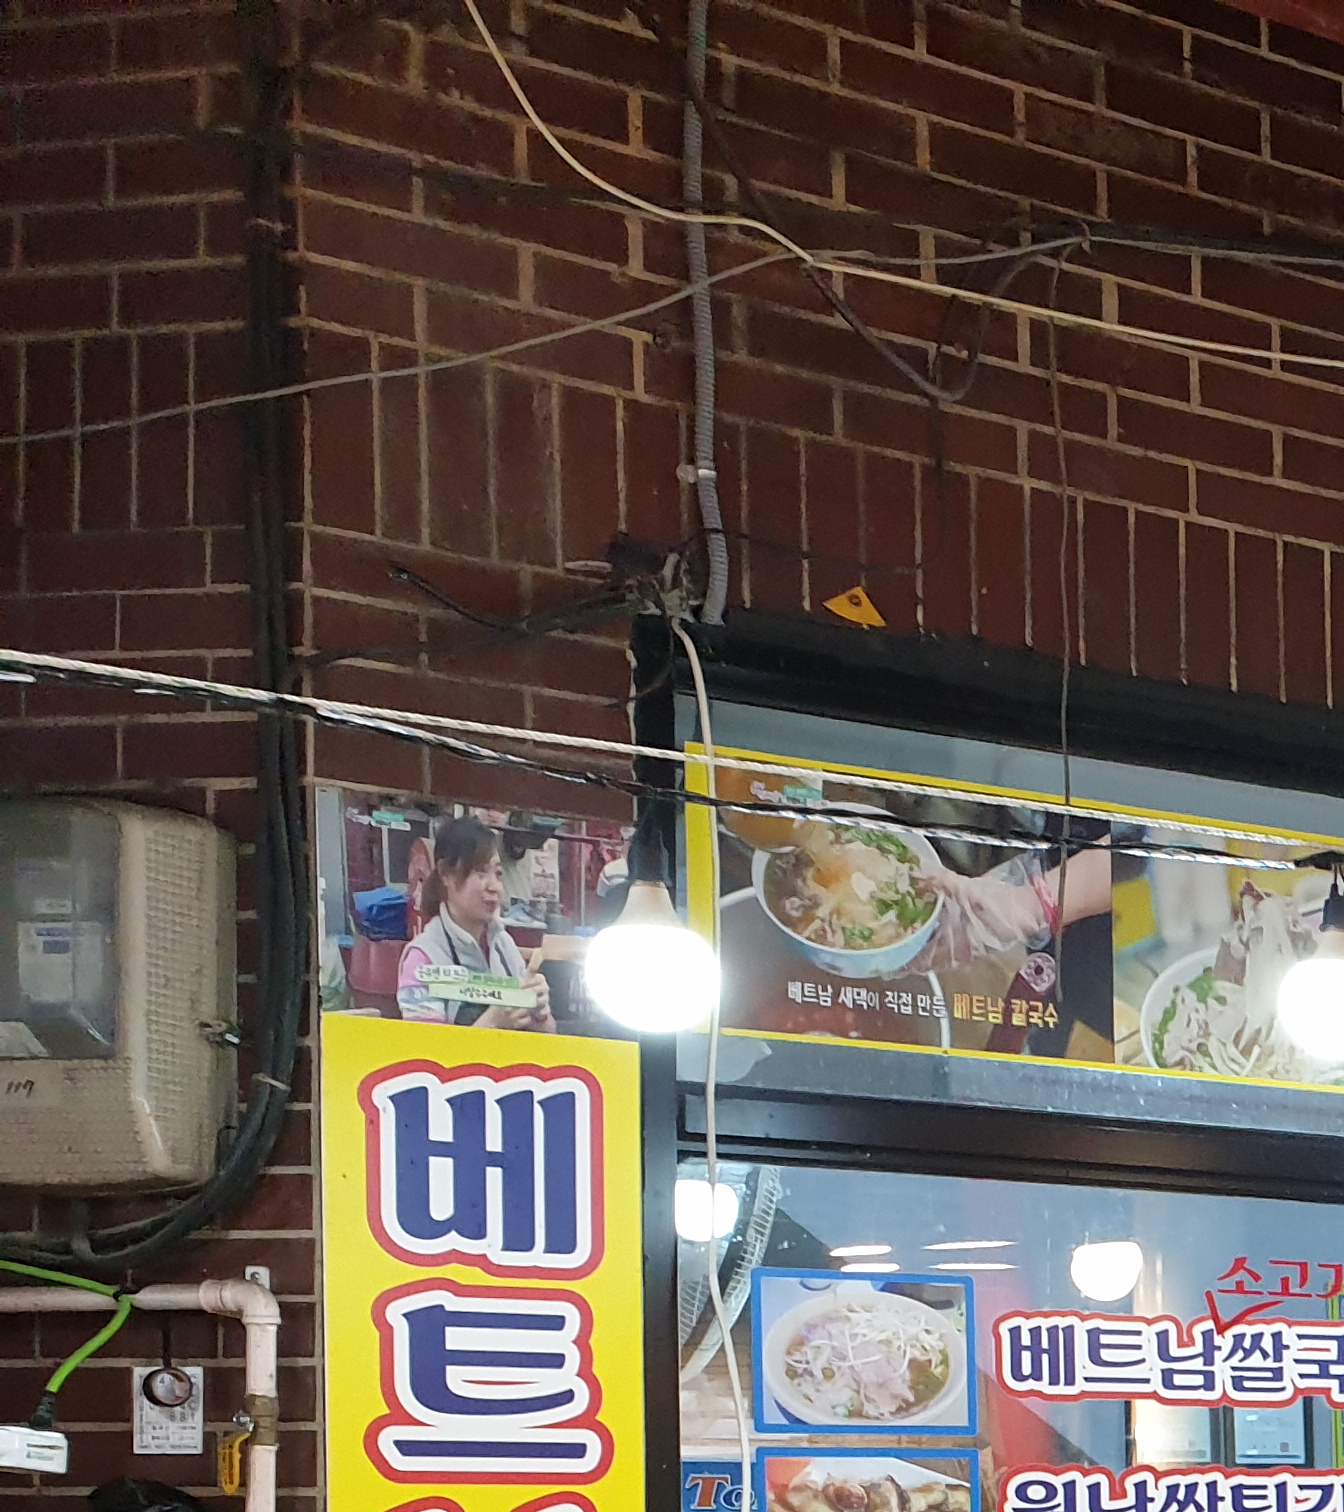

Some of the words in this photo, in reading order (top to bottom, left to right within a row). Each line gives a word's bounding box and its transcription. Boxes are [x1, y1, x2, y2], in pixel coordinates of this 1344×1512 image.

[788, 981, 834, 1006] 베트남
[884, 991, 912, 1015] 직접
[917, 994, 947, 1018] 만든
[954, 993, 1004, 1025] 베트남
